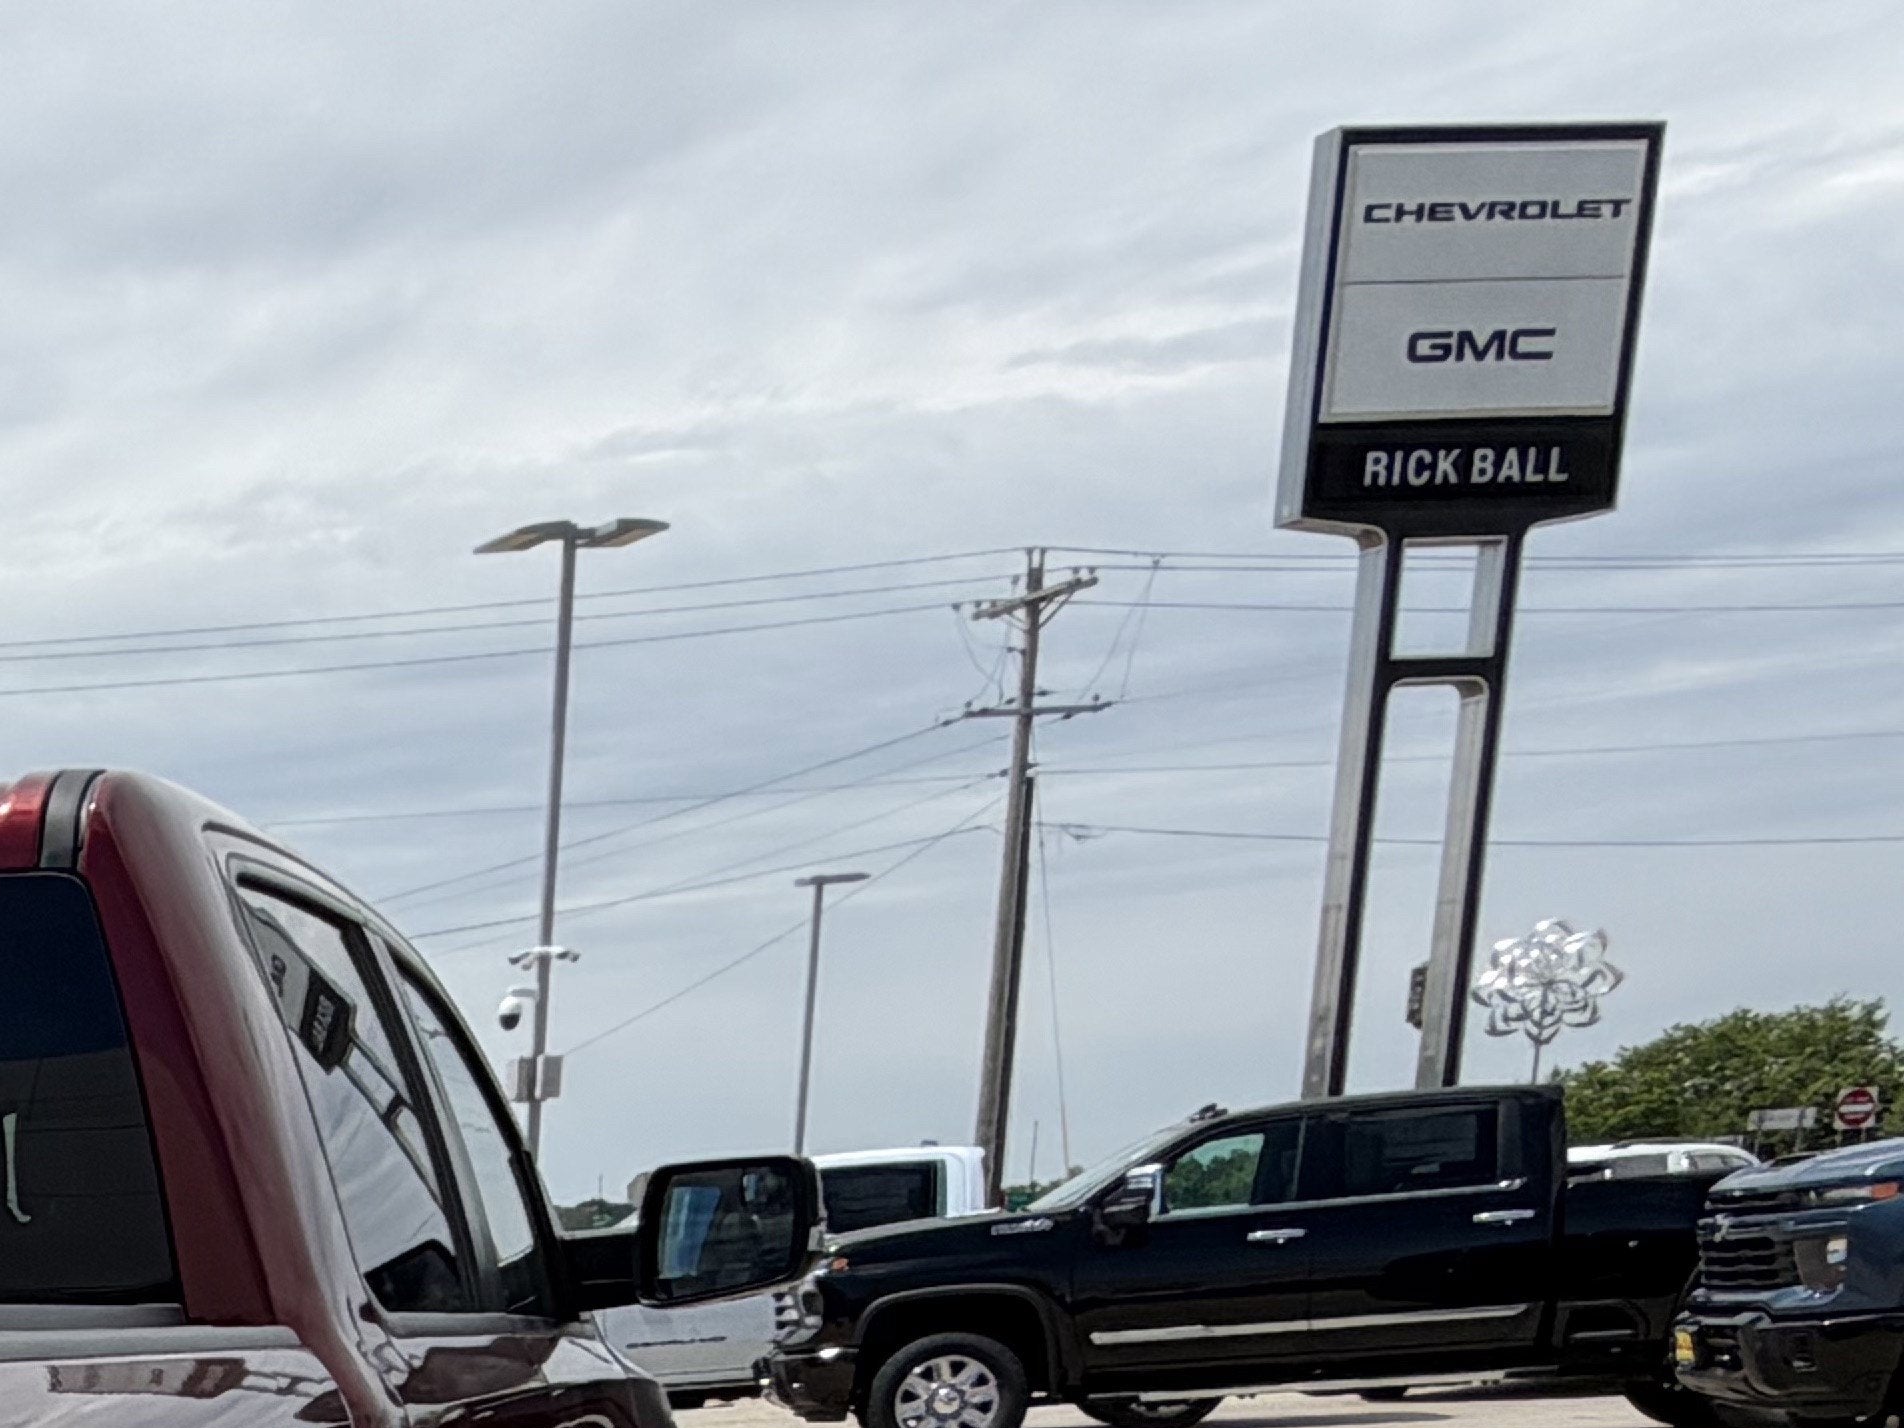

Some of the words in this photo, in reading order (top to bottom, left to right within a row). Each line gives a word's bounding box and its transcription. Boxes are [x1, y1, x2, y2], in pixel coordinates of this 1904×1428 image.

[1363, 198, 1632, 224] CHEVROLET
[1406, 328, 1556, 363] GMC
[1363, 448, 1462, 487] RICK
[1470, 446, 1570, 485] BALL
